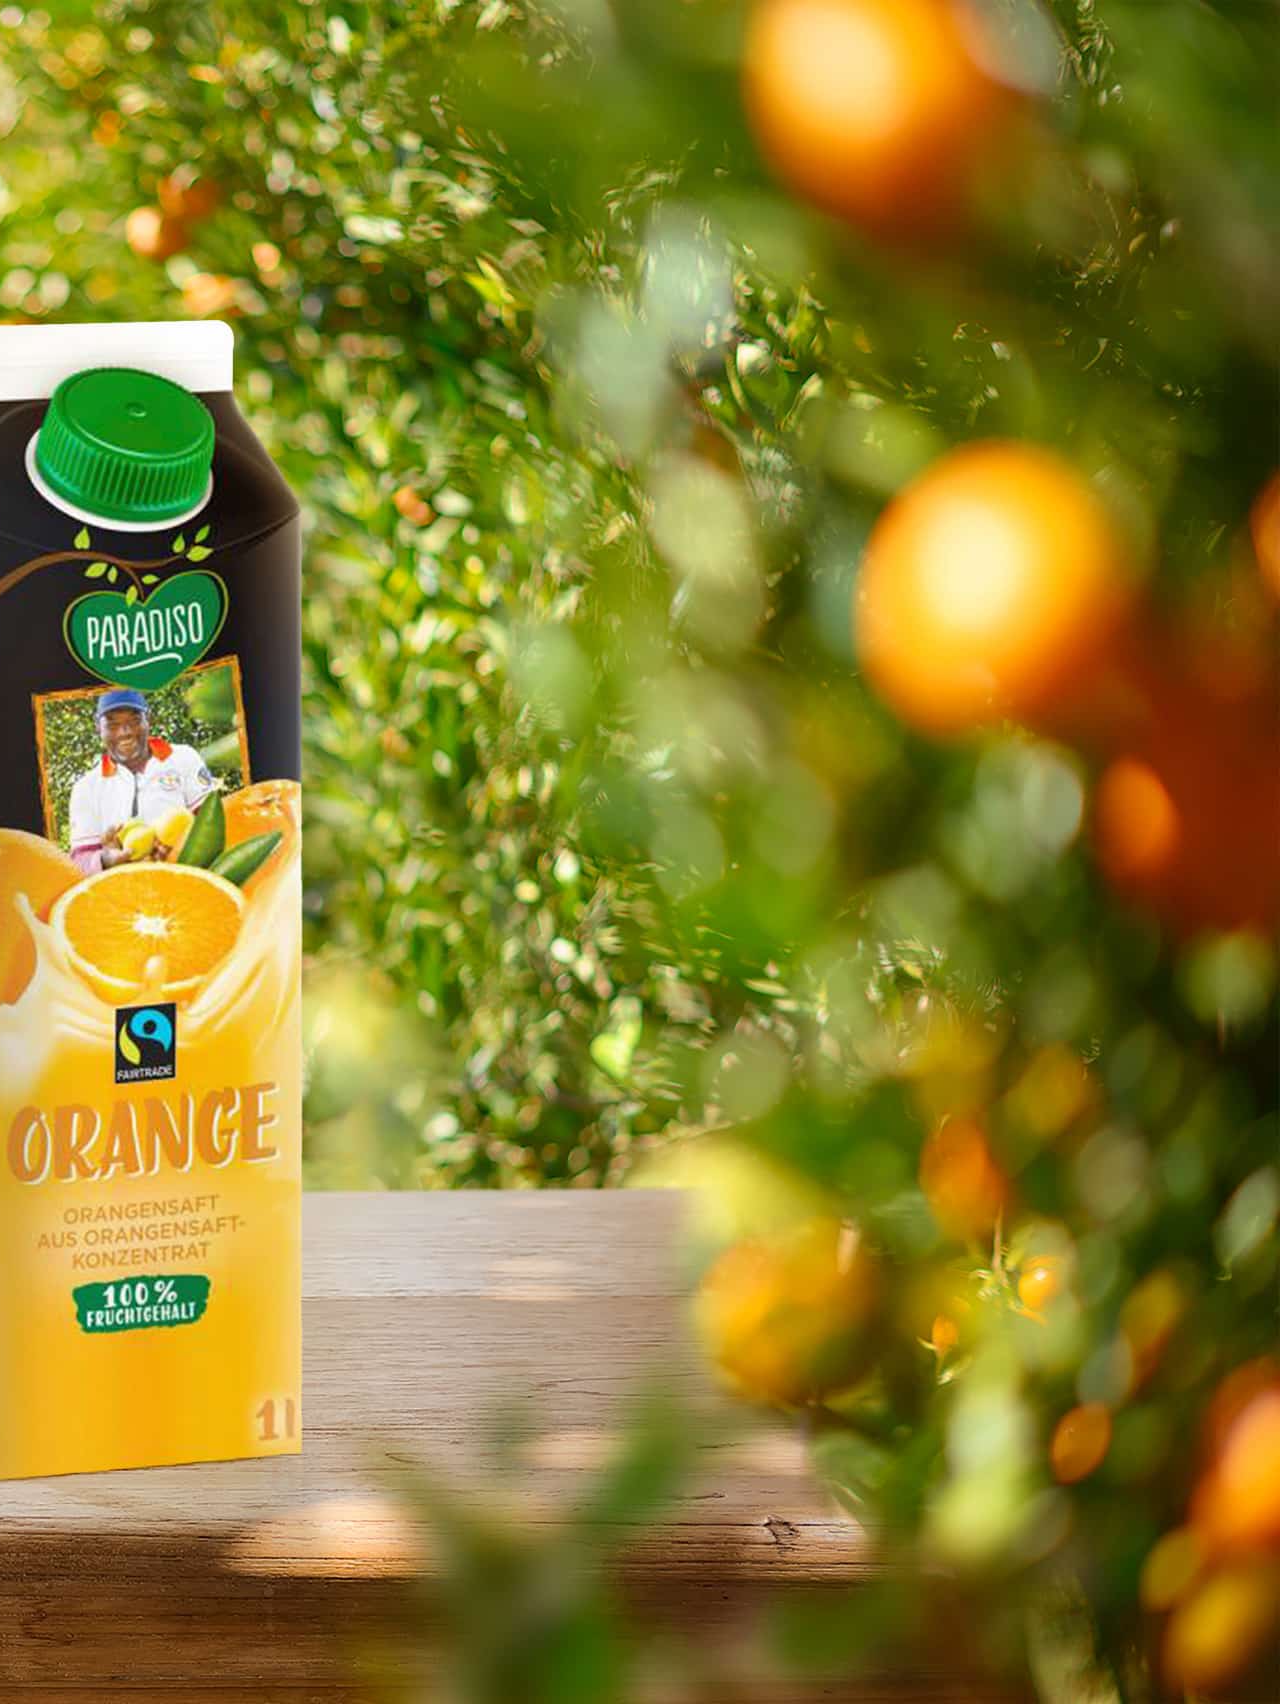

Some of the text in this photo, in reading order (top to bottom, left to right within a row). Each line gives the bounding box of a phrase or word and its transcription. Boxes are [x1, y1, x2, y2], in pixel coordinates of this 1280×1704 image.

[86, 602, 205, 660] PARADISO
[117, 1065, 174, 1081] FAIRTRADE
[7, 1081, 282, 1186] ORANGE
[63, 1194, 220, 1225] ORANGENSAFT
[37, 1215, 247, 1250] AUS ORANGENSAFT-
[71, 1241, 211, 1270] KONZENTRAT
[102, 1284, 150, 1308] 100
[86, 1300, 197, 1328] FRUCHTGEHALT
